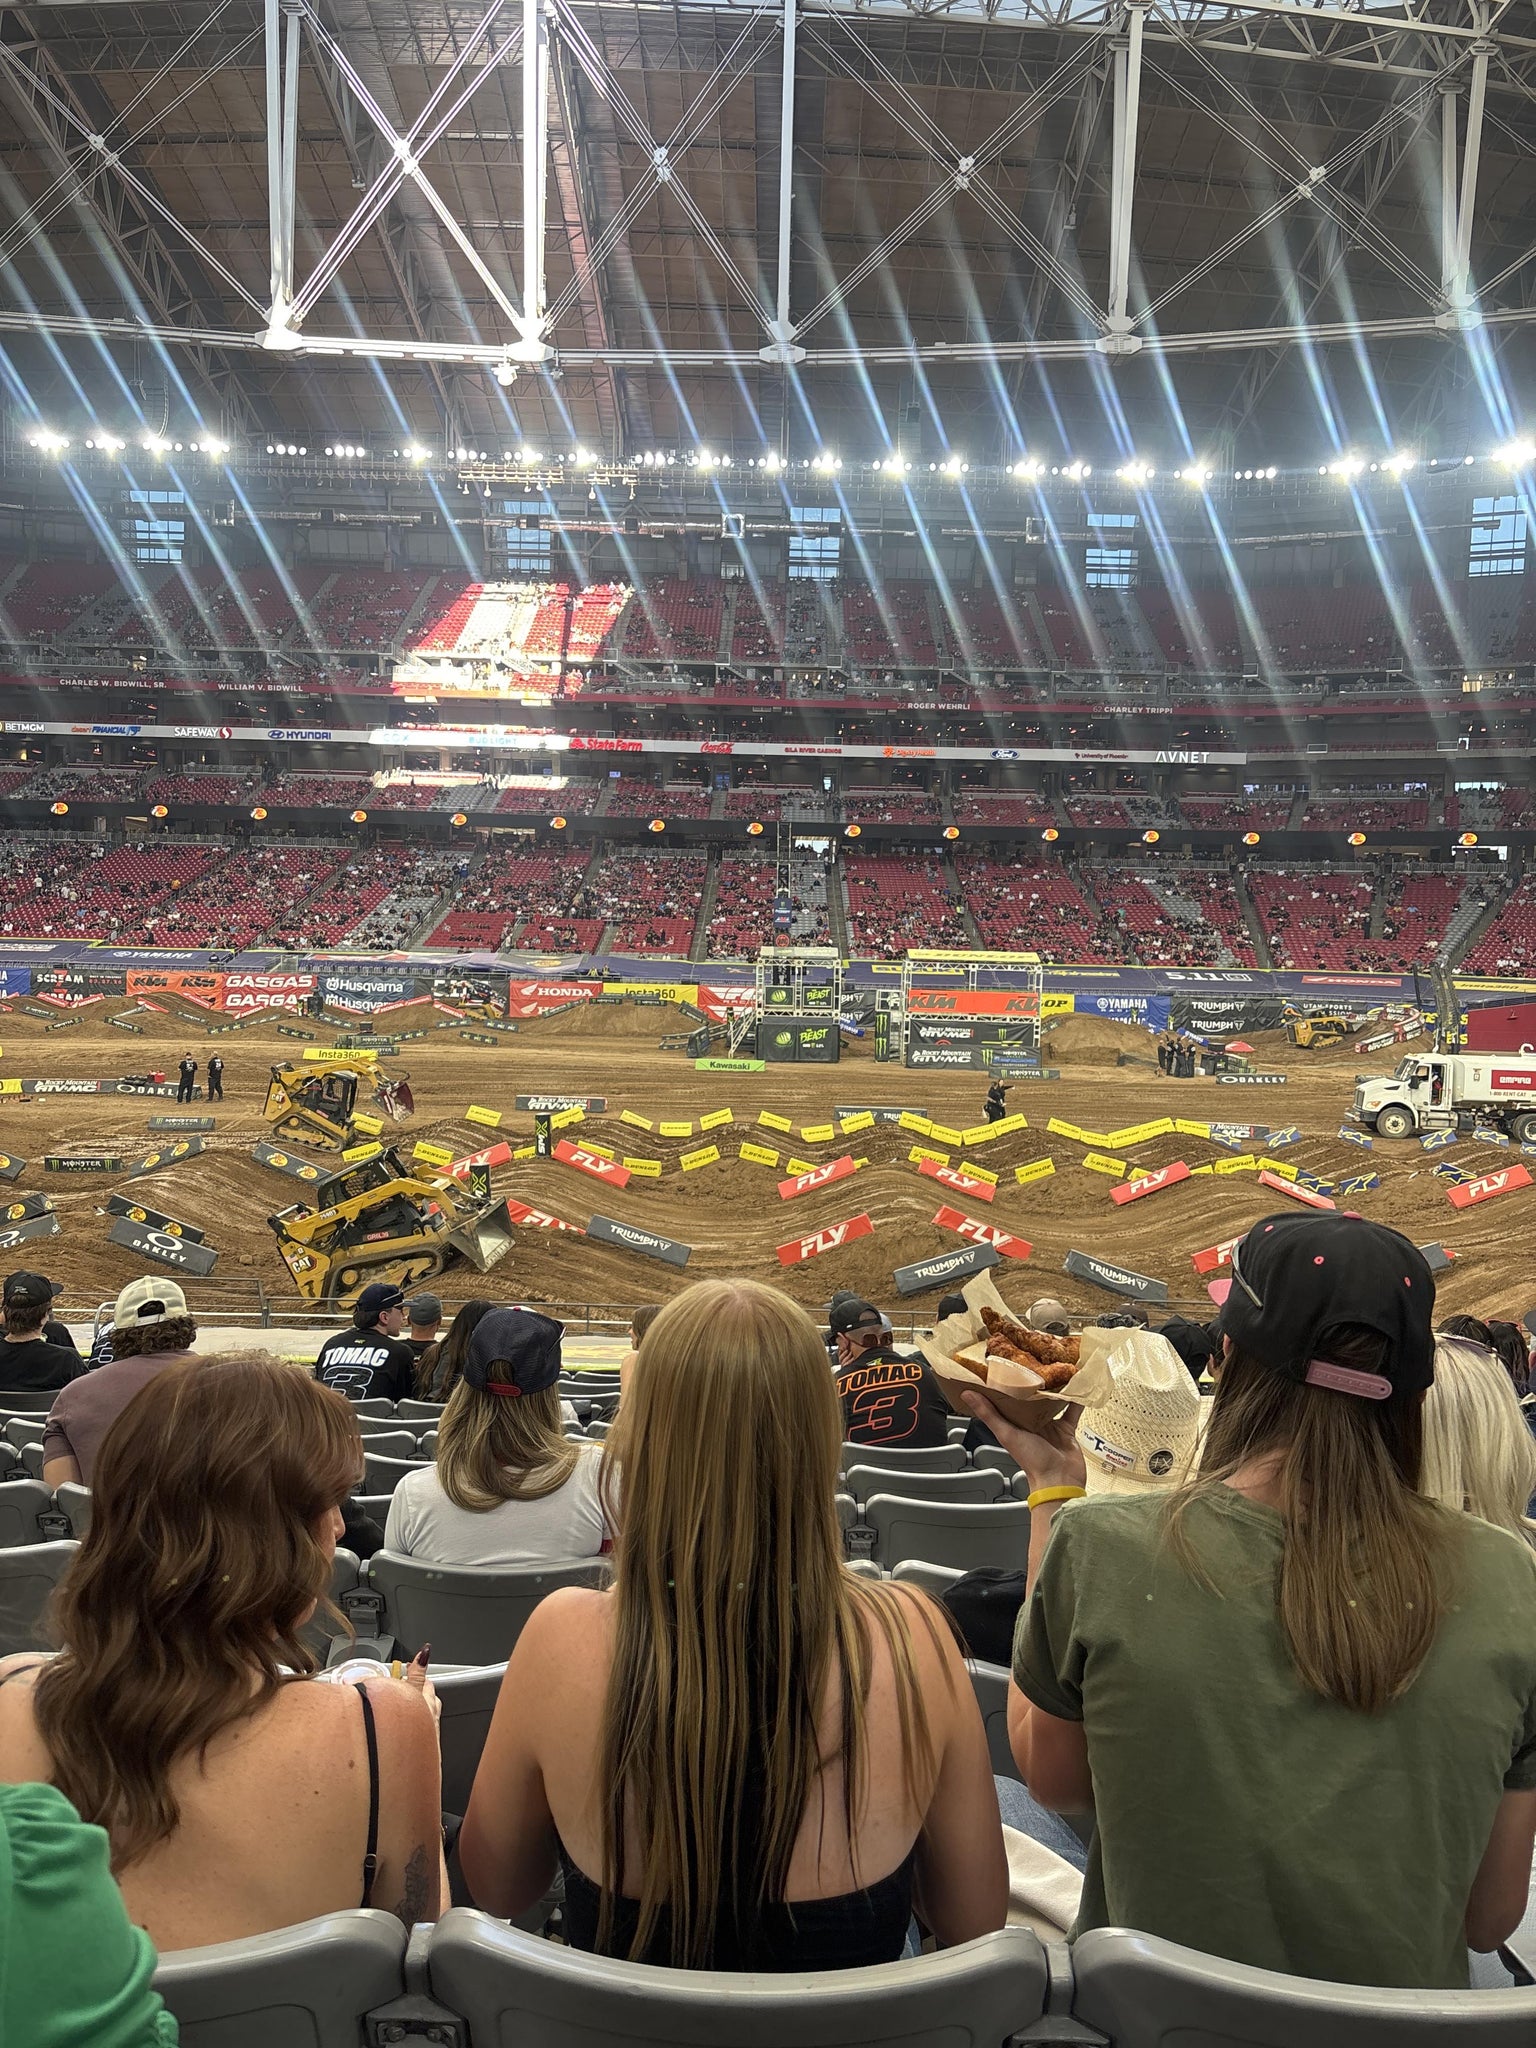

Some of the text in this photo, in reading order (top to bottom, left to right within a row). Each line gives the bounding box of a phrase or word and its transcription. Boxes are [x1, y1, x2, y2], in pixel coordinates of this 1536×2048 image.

[114, 680, 151, 689] BIDWILL,
[5, 724, 44, 732] BETMGM
[174, 728, 218, 738] SAFEWAY
[995, 750, 1014, 759] Ford
[1155, 751, 1210, 764] AVNET
[131, 951, 193, 959] YAMAHA
[36, 974, 84, 984] SCREAM
[133, 974, 168, 986] KTM
[180, 975, 216, 988] KTM
[226, 975, 312, 988] GASGAS
[340, 980, 404, 994] Husqvarna
[538, 988, 594, 997] HONDA
[806, 988, 830, 1000] BEAST
[910, 994, 958, 1010] KTM
[1108, 998, 1148, 1010] YAMAHA
[1192, 1002, 1234, 1012] TRIUMPH
[1190, 1020, 1234, 1031] TRIUMPH
[800, 1028, 828, 1043] BEAST
[710, 1061, 750, 1070] Kawasaki
[570, 1151, 616, 1174] FLY
[690, 1152, 716, 1164] DUNLOP
[748, 1150, 776, 1162] DUNLOP
[1026, 1164, 1052, 1177] DUNLOP
[1096, 1161, 1123, 1172] DUNLOP
[1227, 1160, 1253, 1170] DUNLOP
[797, 1164, 836, 1190] FLY
[936, 1168, 980, 1188] FLY
[968, 1170, 995, 1183] DUNLOP
[1130, 1170, 1168, 1194] FLY
[1468, 1172, 1509, 1198] FLY
[610, 1224, 658, 1248] TRIUMPH
[957, 1217, 1014, 1248] FLY
[800, 1224, 850, 1258] FLY
[132, 1240, 187, 1262] OAKLEY
[292, 1256, 312, 1274] CAT
[915, 1258, 964, 1278] TRIUMPH
[1089, 1262, 1136, 1286] TRIUMPH
[322, 1346, 390, 1368] TOMAC
[836, 1364, 922, 1398] TOMAC
[848, 1383, 920, 1445] 3
[1103, 1445, 1134, 1463] COOPER
